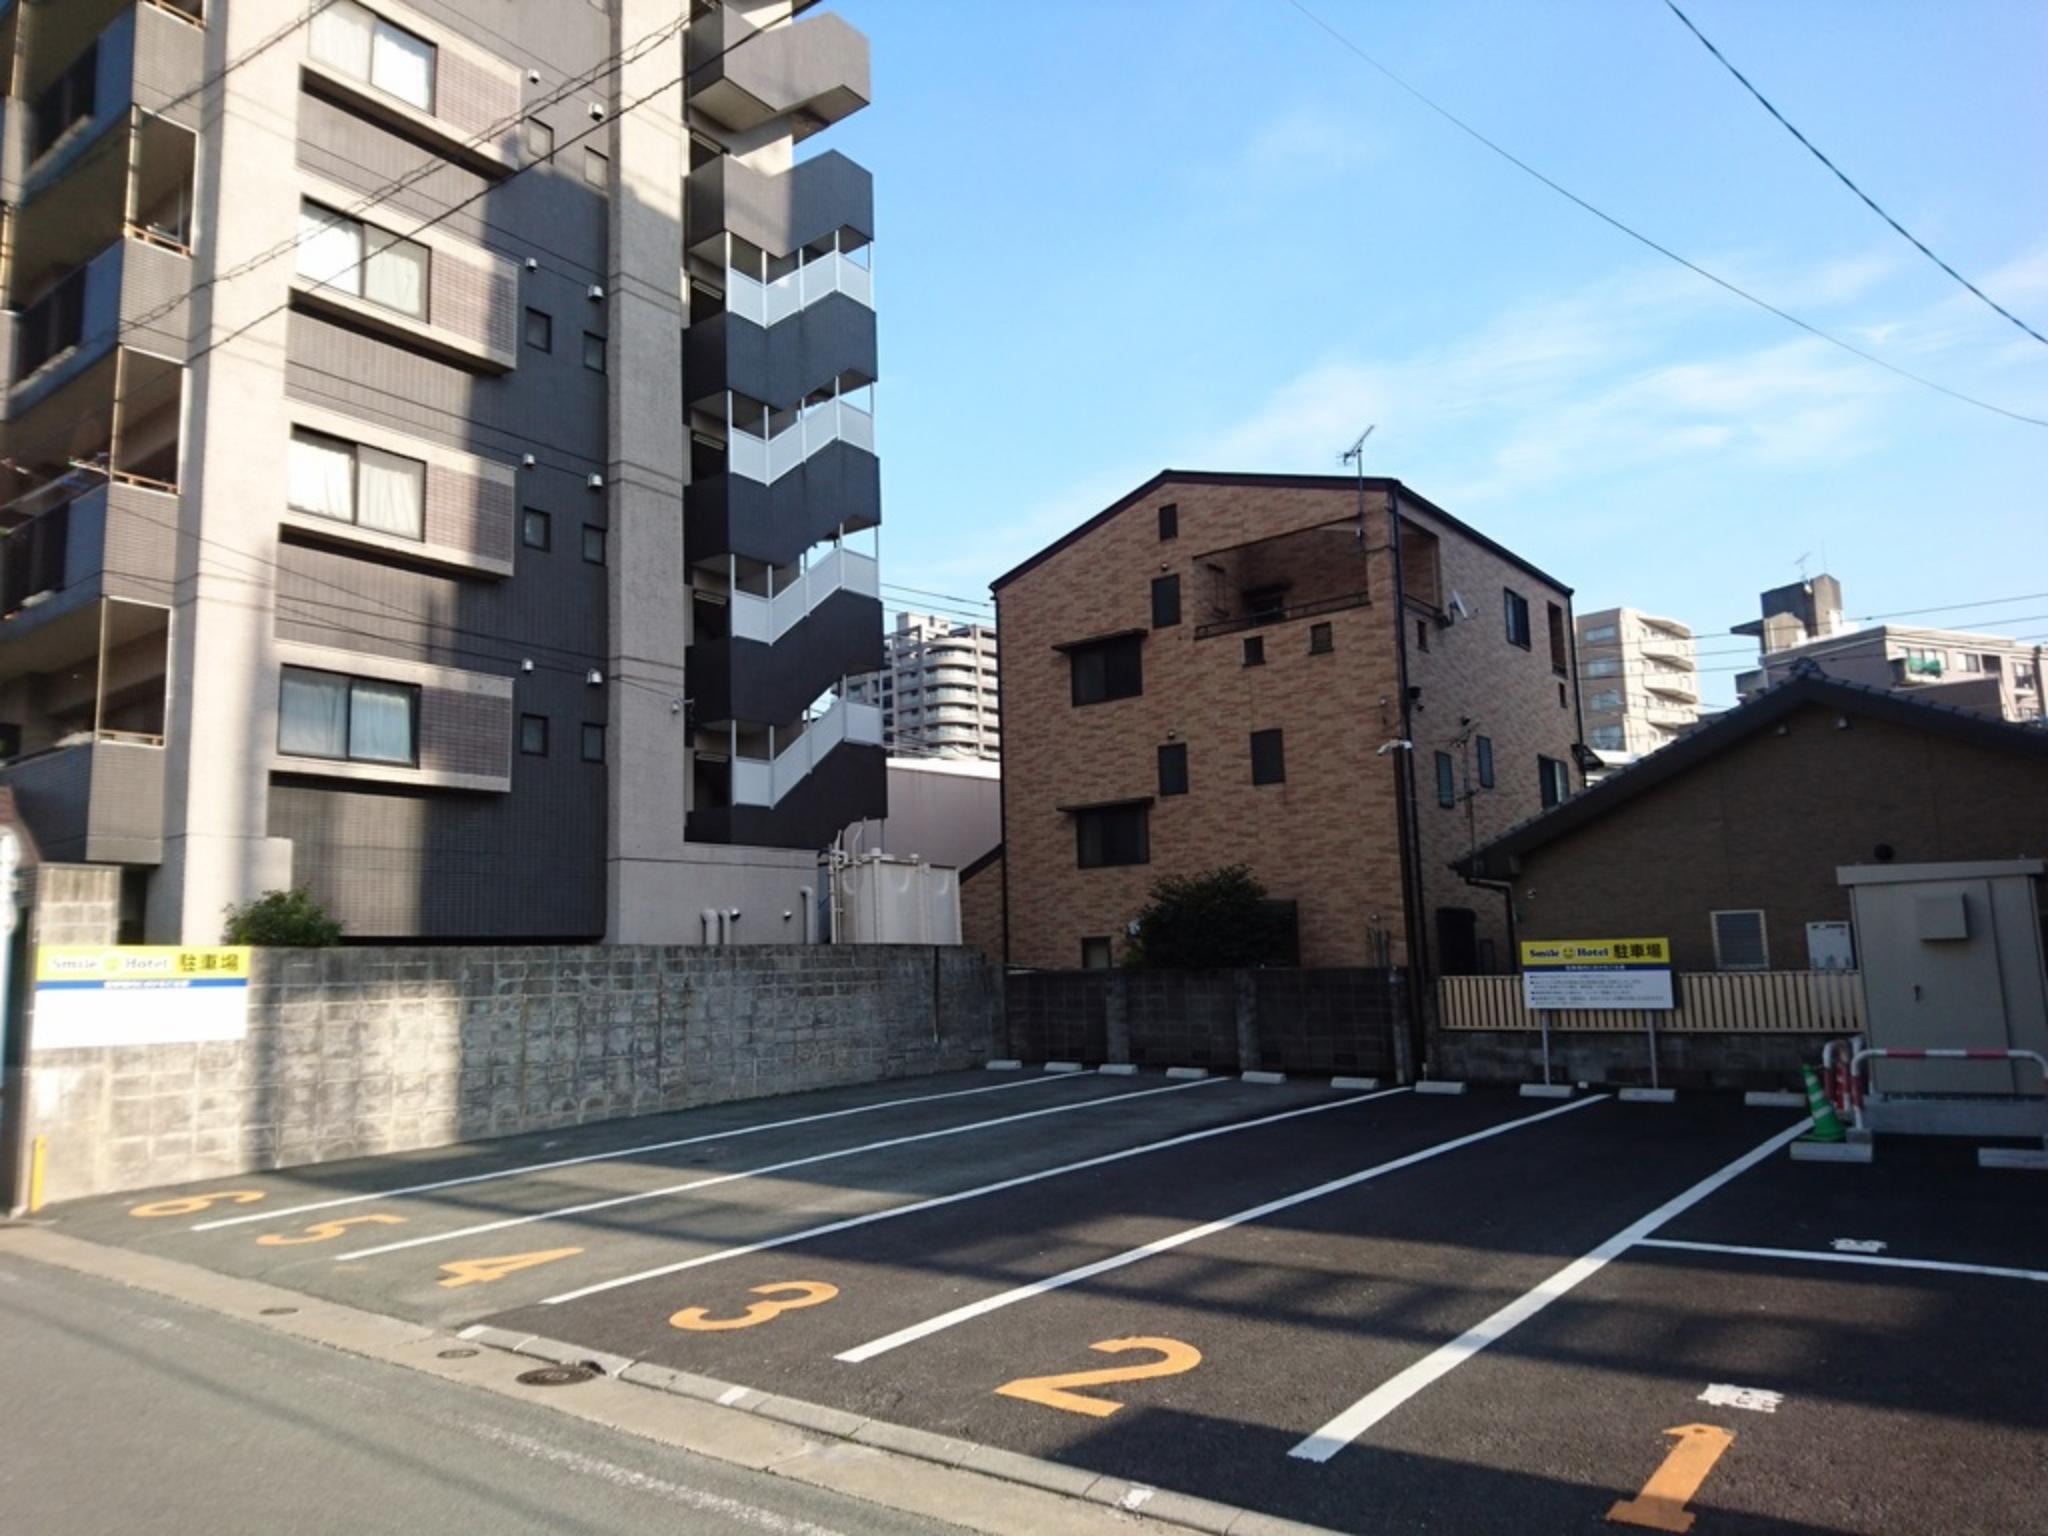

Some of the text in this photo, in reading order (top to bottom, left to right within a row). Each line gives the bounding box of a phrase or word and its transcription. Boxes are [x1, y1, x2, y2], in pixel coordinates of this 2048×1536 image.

[53, 953, 239, 972] Smile Hotel 駐車場
[1530, 943, 1662, 959] Smile Hotel 駐車場
[130, 1190, 265, 1218] 6
[257, 1214, 405, 1246] 5
[438, 1246, 583, 1287] 4
[670, 1280, 838, 1332] 3
[997, 1333, 1205, 1419] 2
[1605, 1422, 1738, 1533] 1
